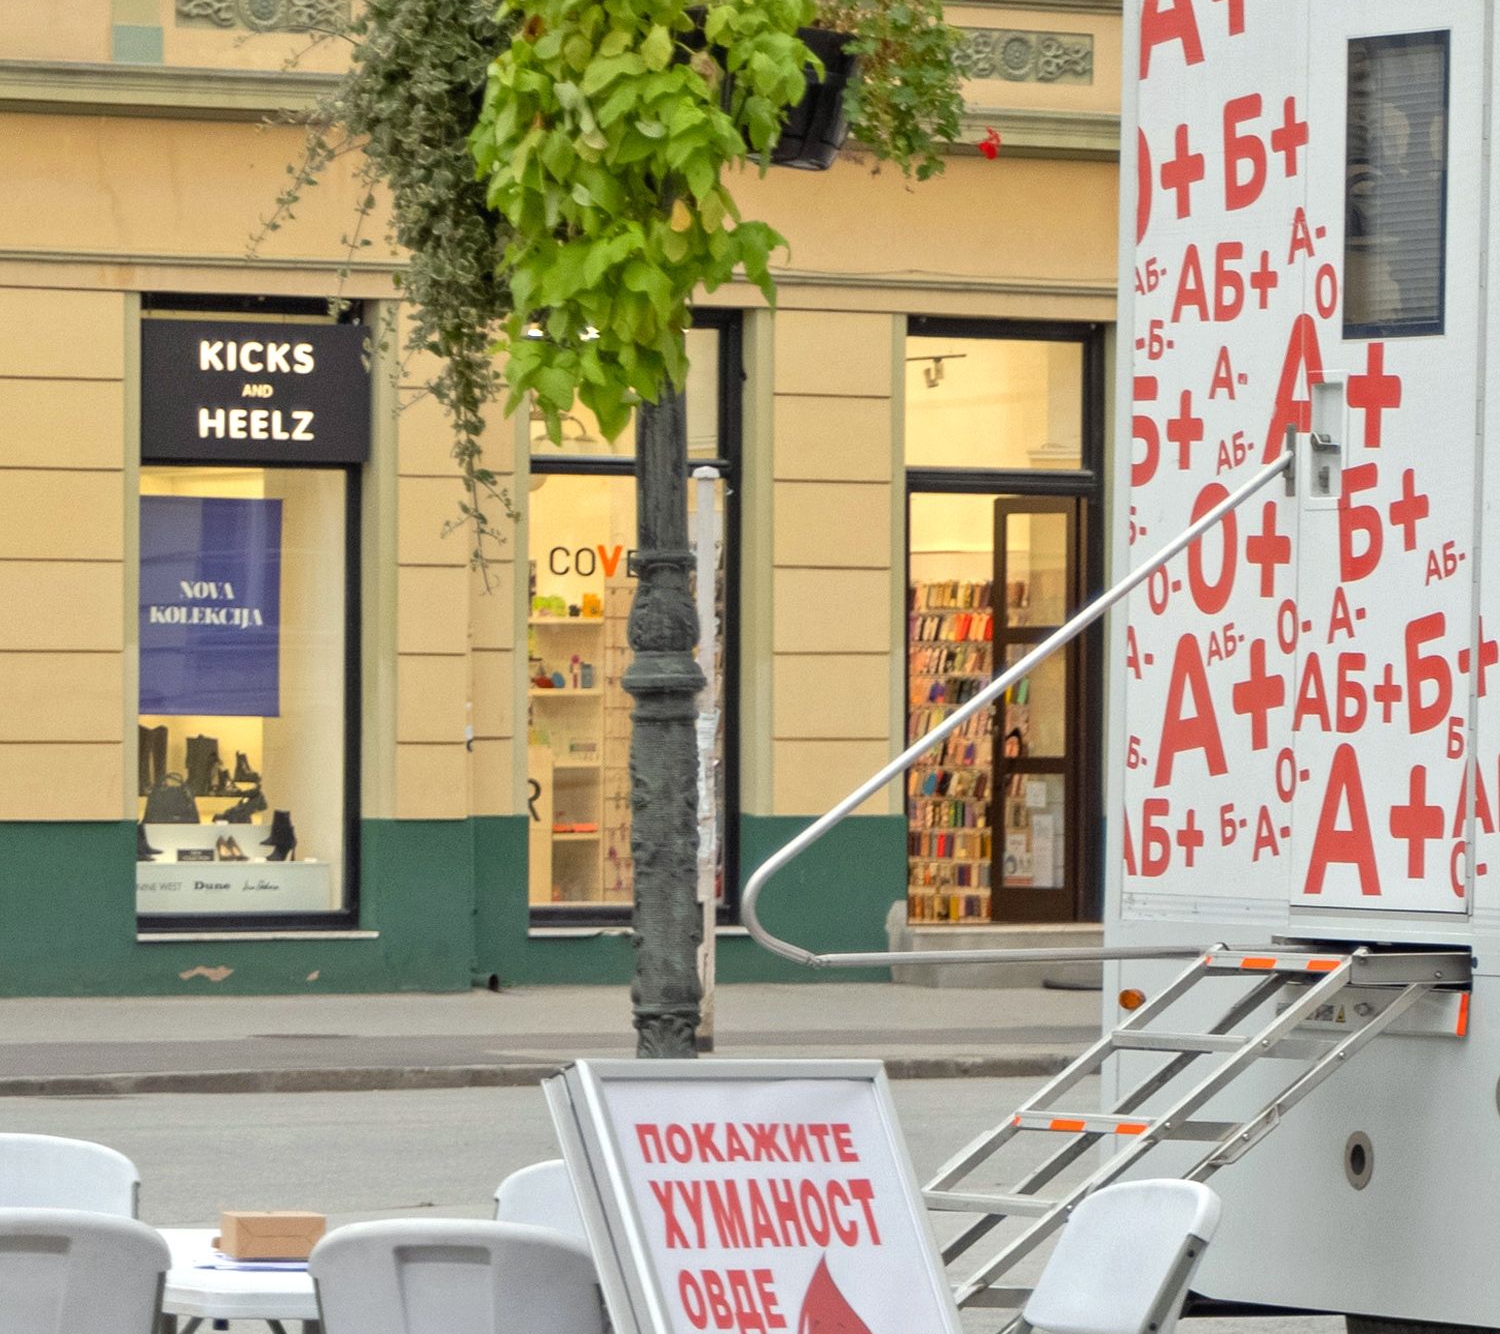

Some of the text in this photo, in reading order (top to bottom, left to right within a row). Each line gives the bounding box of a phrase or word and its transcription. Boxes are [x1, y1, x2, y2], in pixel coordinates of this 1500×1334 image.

[1222, 93, 1309, 212] Б+
[1171, 242, 1278, 323] АБ+
[199, 339, 315, 374] KICKS
[241, 383, 274, 399] AND
[198, 407, 315, 441] HEELZ
[1338, 462, 1430, 583] Б+
[149, 605, 263, 629] KOLEKCIJA
[180, 580, 235, 600] NOVA
[1154, 633, 1287, 788] А+
[1292, 651, 1402, 734] АБ+
[1405, 611, 1500, 735] Б+
[1304, 742, 1445, 897] А+
[635, 1123, 860, 1164] ПОКАЖИТЕ
[649, 1178, 882, 1249] ХУМАНОСТ
